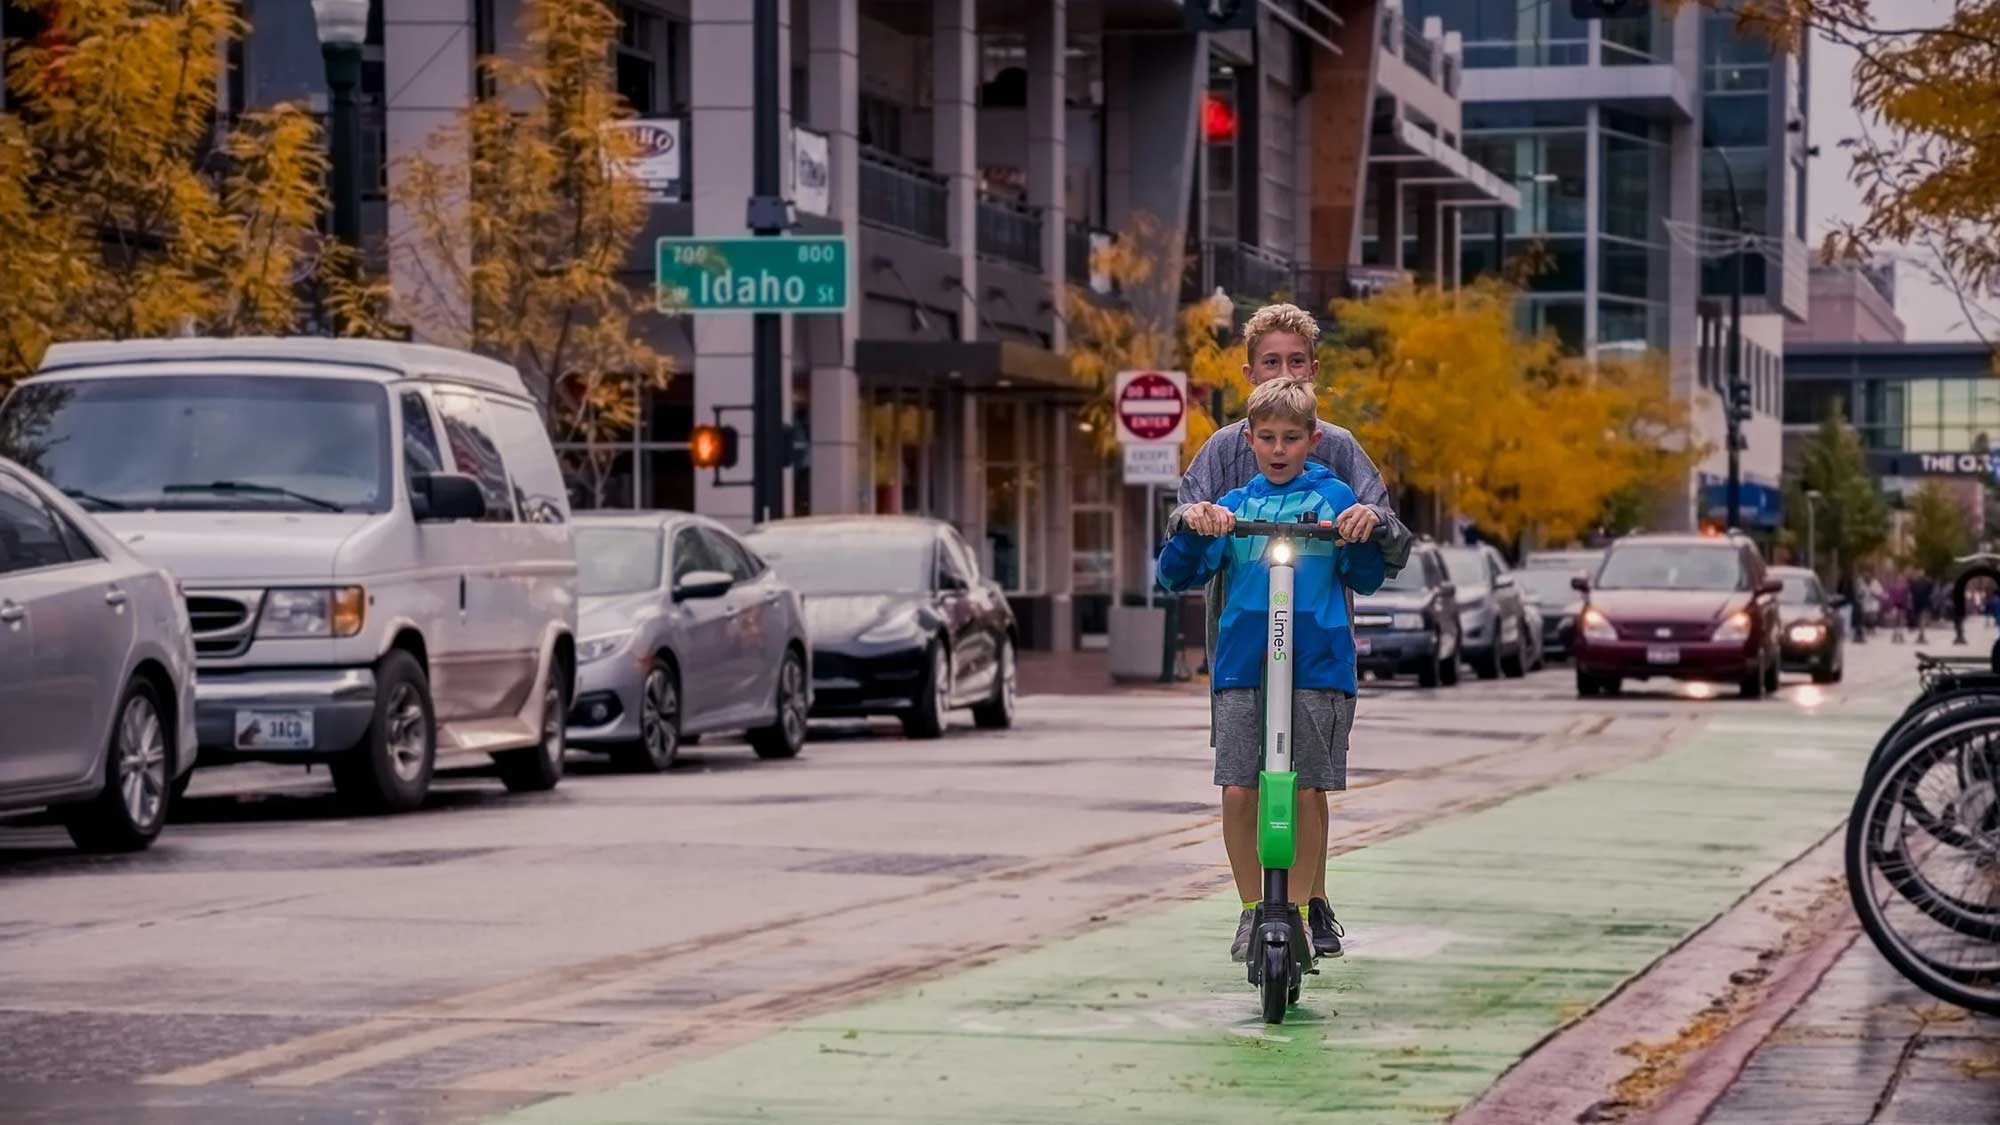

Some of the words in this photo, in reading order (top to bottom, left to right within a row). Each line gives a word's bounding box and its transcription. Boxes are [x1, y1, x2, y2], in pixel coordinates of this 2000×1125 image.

[673, 245, 707, 264] 700
[798, 245, 835, 262] 800
[701, 269, 805, 304] Idaho
[818, 285, 835, 303] St
[1126, 385, 1145, 397] DO
[1150, 385, 1174, 397] NOT
[1131, 416, 1170, 429] ENTER
[1131, 450, 1169, 460] EXCEPT
[1921, 453, 1955, 473] THE
